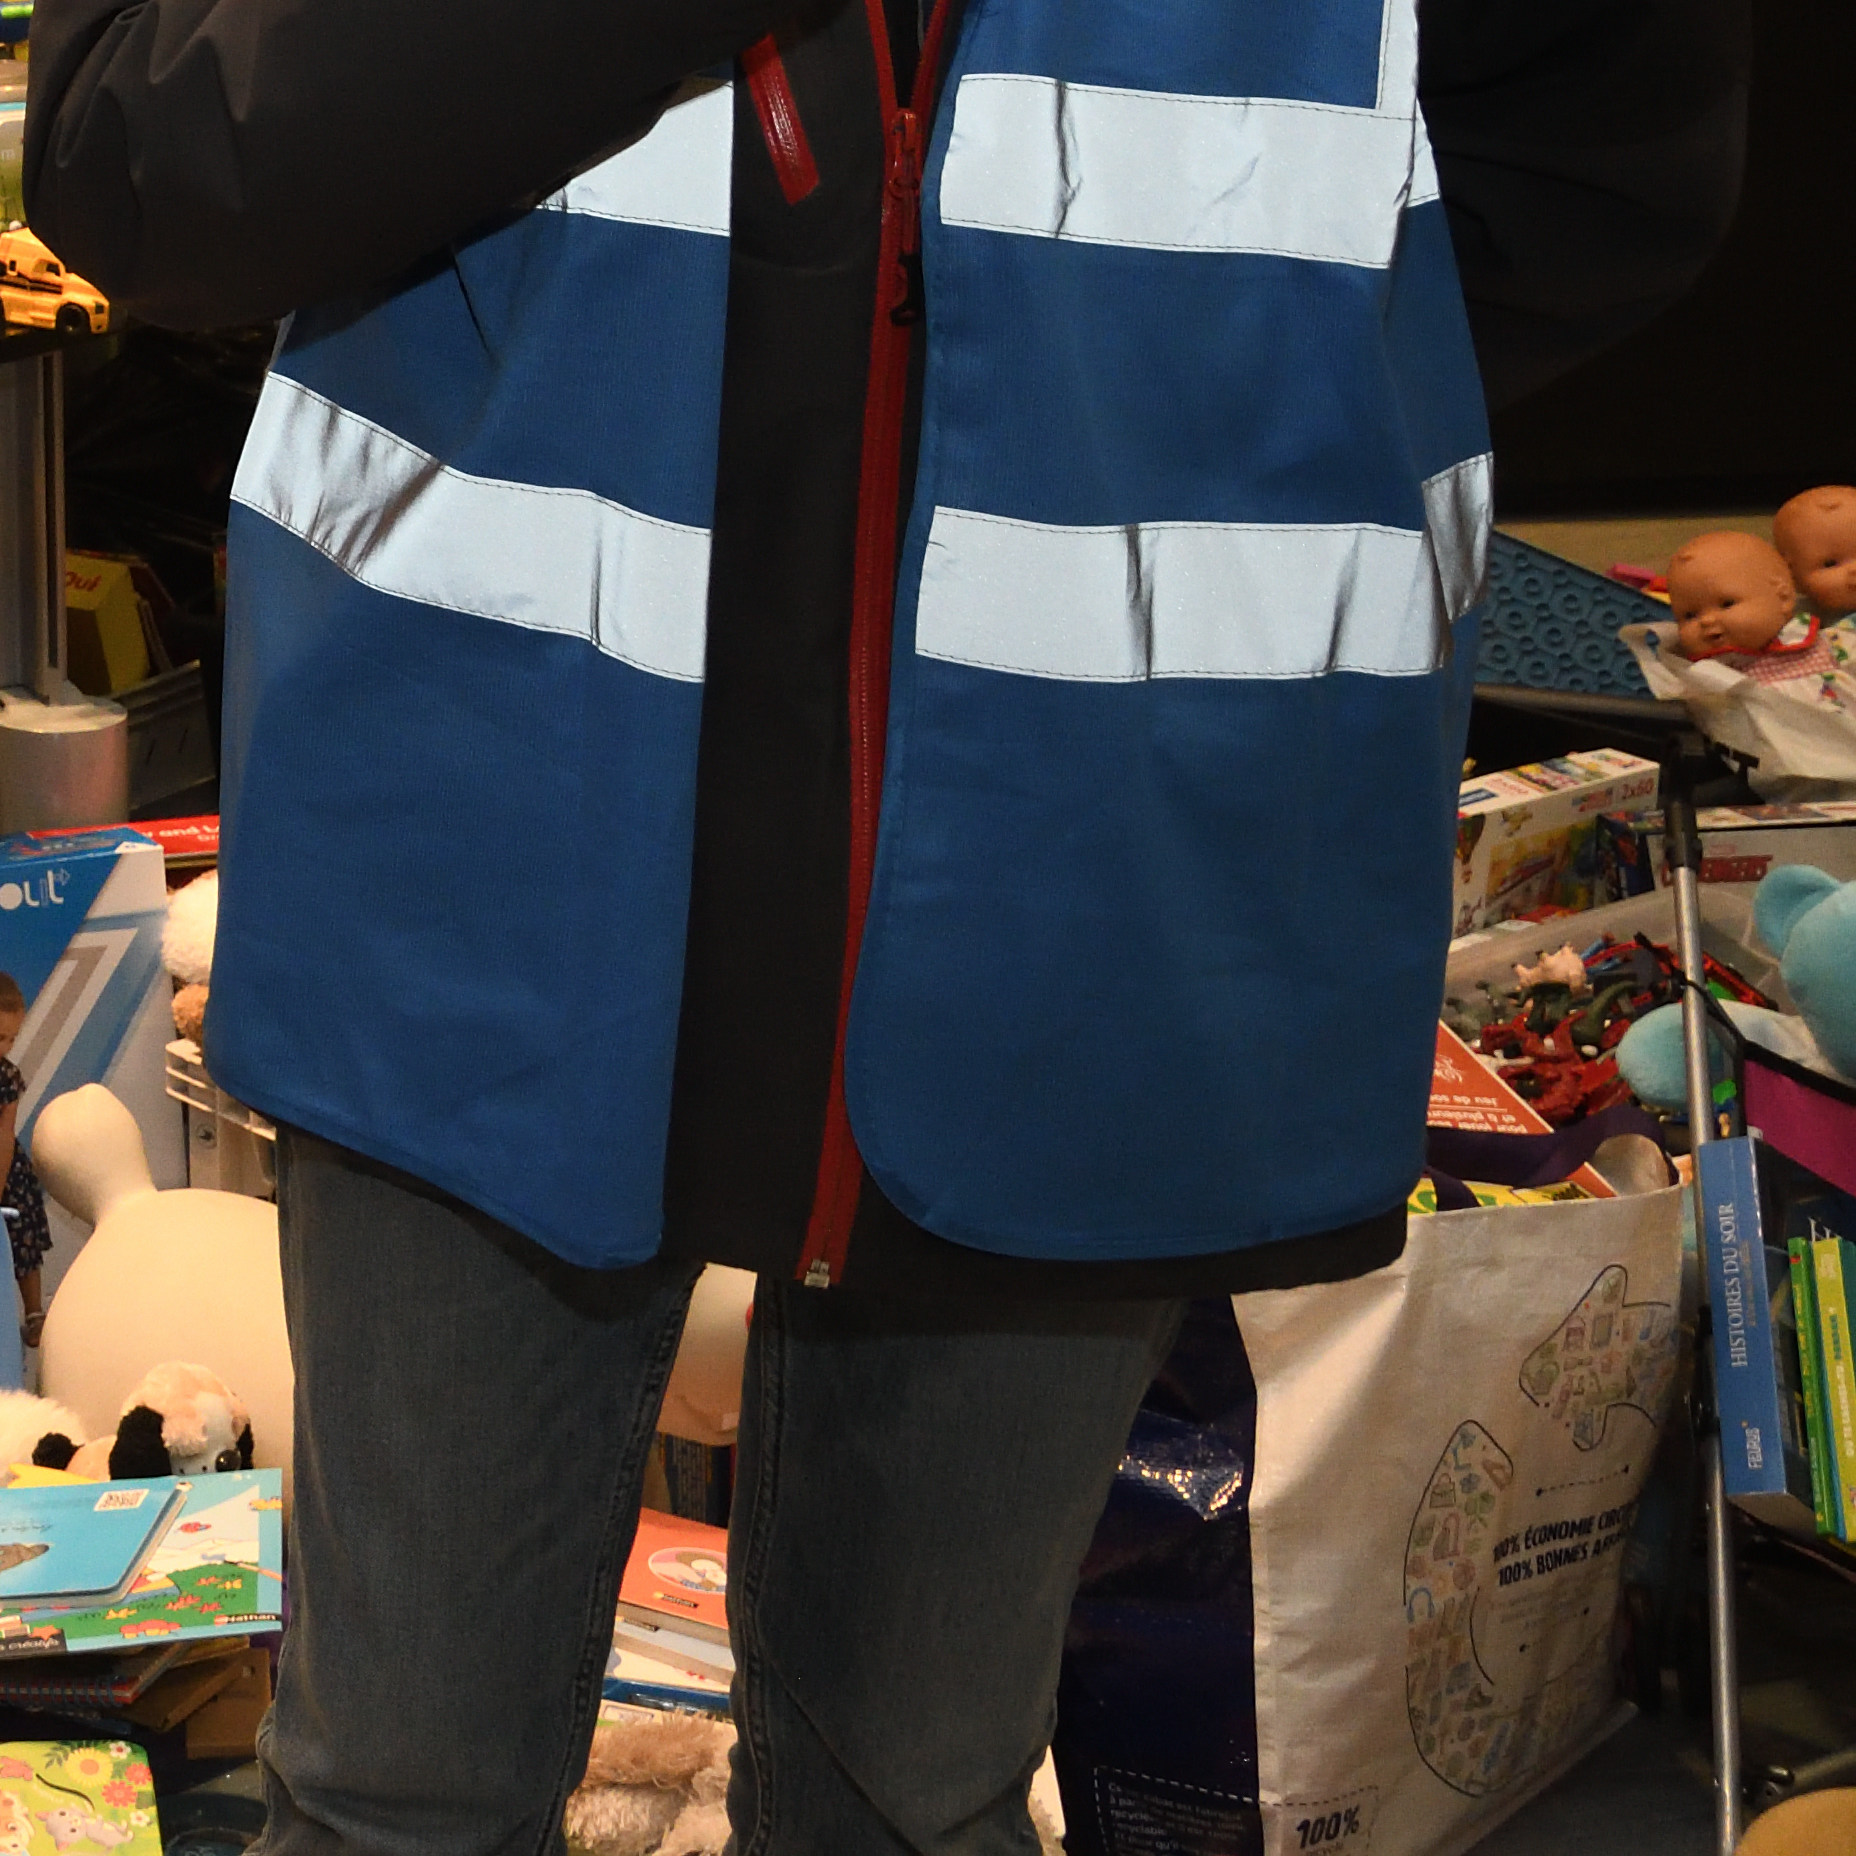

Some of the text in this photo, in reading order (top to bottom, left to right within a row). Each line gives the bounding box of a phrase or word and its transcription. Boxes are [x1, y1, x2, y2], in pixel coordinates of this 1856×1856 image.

[1718, 1204, 1737, 1243] SOIR
[1722, 1246, 1740, 1274] DU
[1725, 1276, 1749, 1367] HISTOIRES
[1524, 1515, 1595, 1550] ÉCONOMIE
[1498, 1558, 1534, 1587] 100%
[1536, 1542, 1588, 1576] BONNES
[1296, 1805, 1360, 1850] 100%
